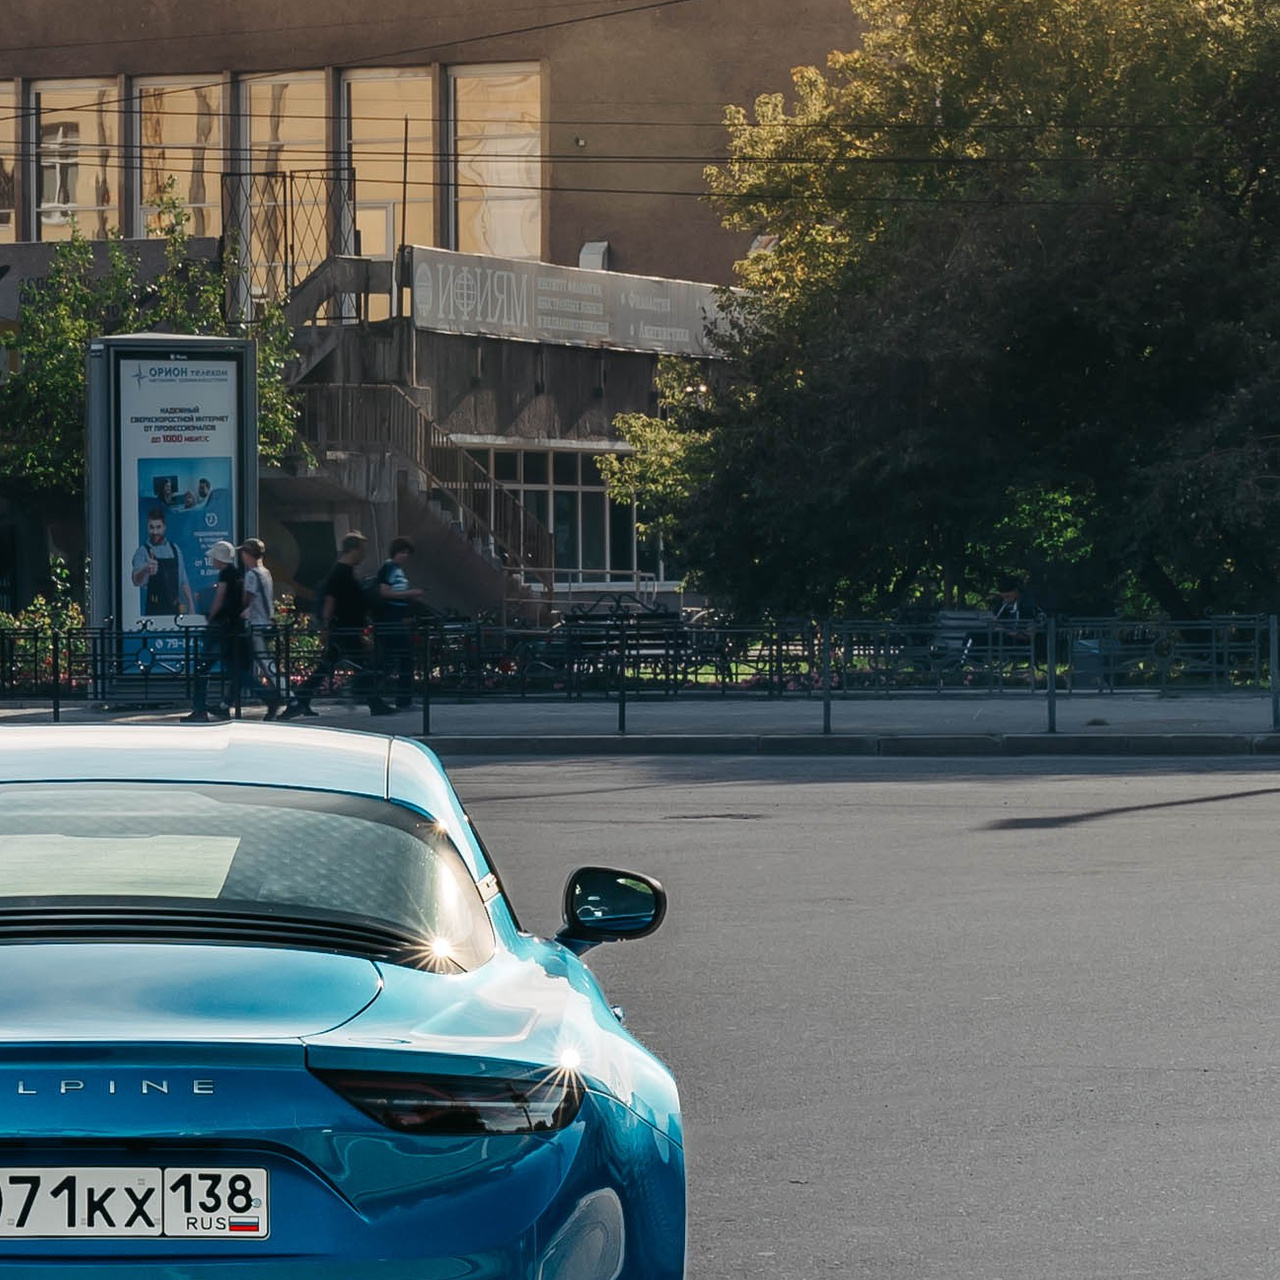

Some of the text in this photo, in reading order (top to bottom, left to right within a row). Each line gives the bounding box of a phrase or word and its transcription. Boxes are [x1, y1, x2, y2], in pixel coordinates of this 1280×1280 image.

[149, 367, 188, 378] ОРИОН
[162, 434, 183, 443] 1000
[169, 1173, 254, 1214] 138
[186, 1216, 227, 1231] RUS
